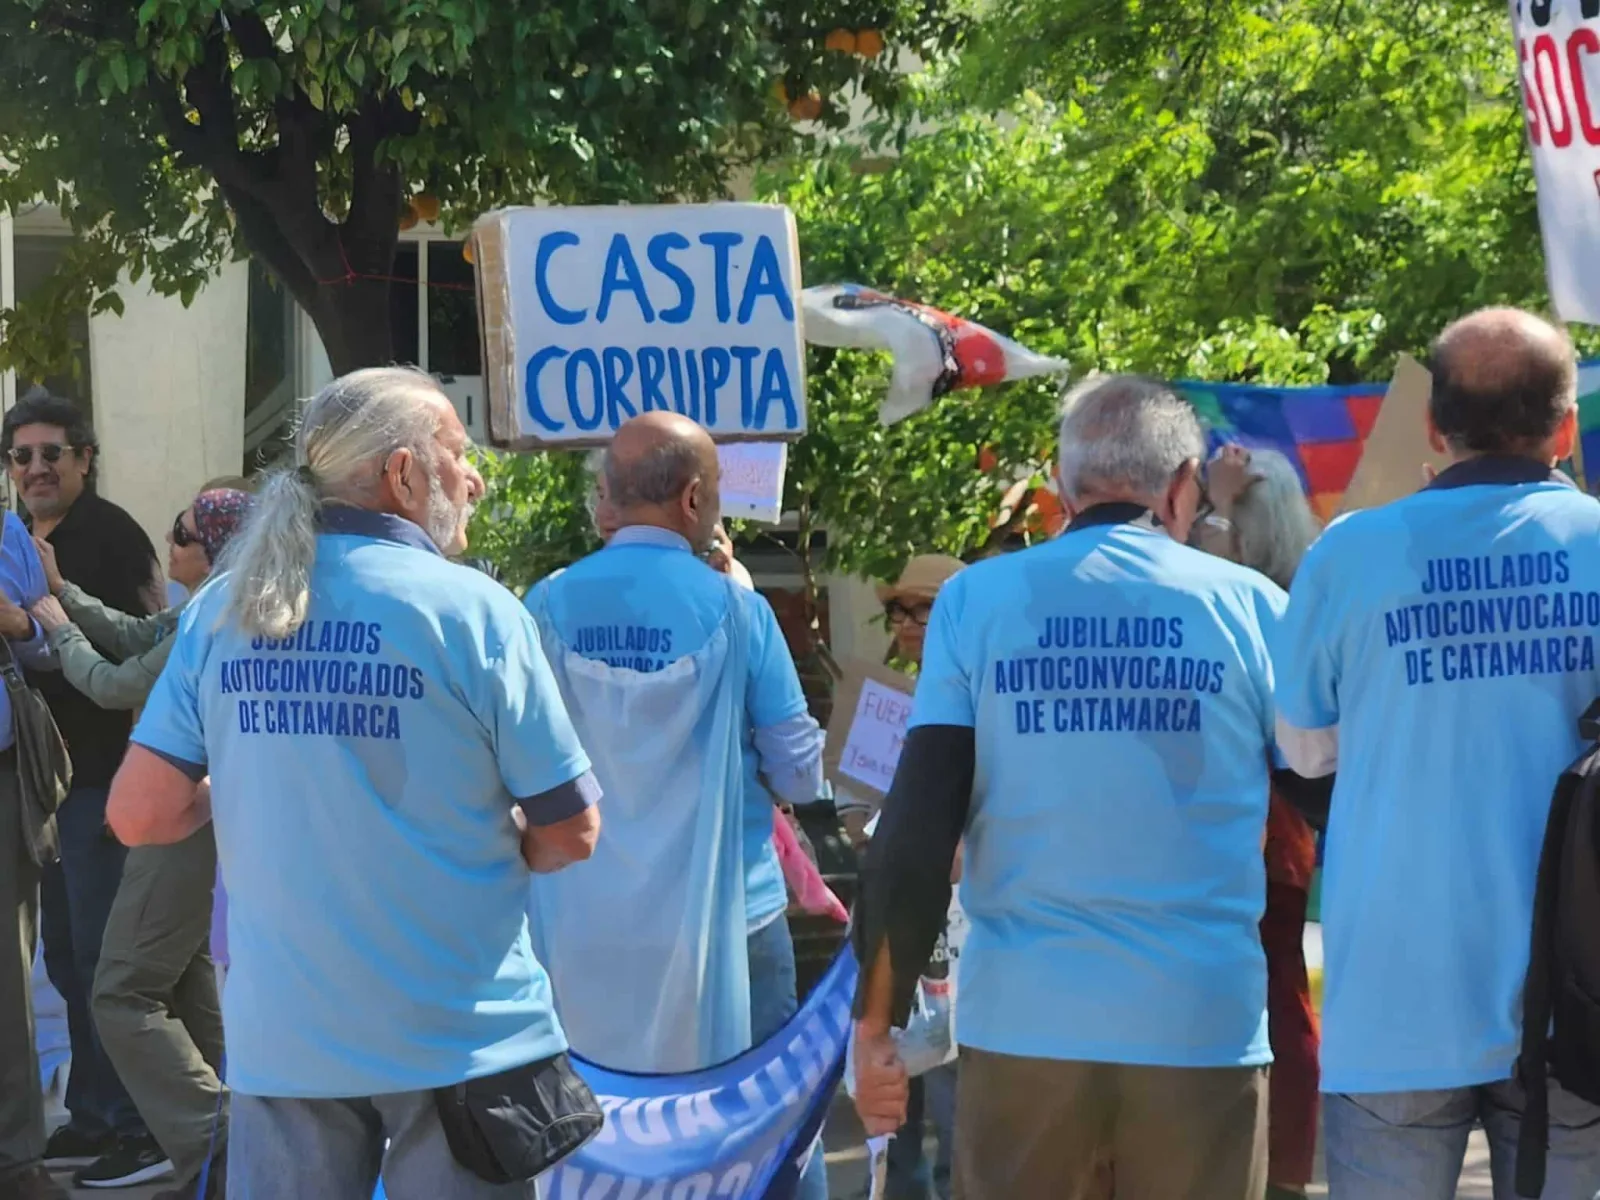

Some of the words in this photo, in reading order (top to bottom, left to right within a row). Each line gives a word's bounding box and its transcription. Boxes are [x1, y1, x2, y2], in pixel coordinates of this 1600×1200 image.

[535, 231, 795, 325] CASTA
[525, 345, 798, 431] CORRUPTA
[1421, 550, 1570, 594] JUBILADOS
[572, 624, 673, 653] JUBILADOS
[1038, 616, 1183, 649] JUBILADOS
[221, 658, 424, 699] AUTOCONVOCADOS
[995, 656, 1225, 694] AUTOCONVOCADOS
[1405, 648, 1433, 686] DE
[1442, 635, 1594, 681] CATAMARCA
[239, 700, 260, 734] DE
[264, 700, 400, 739] CATAMARCA
[1015, 700, 1045, 734] DE
[1054, 697, 1200, 733] CATAMARCA
